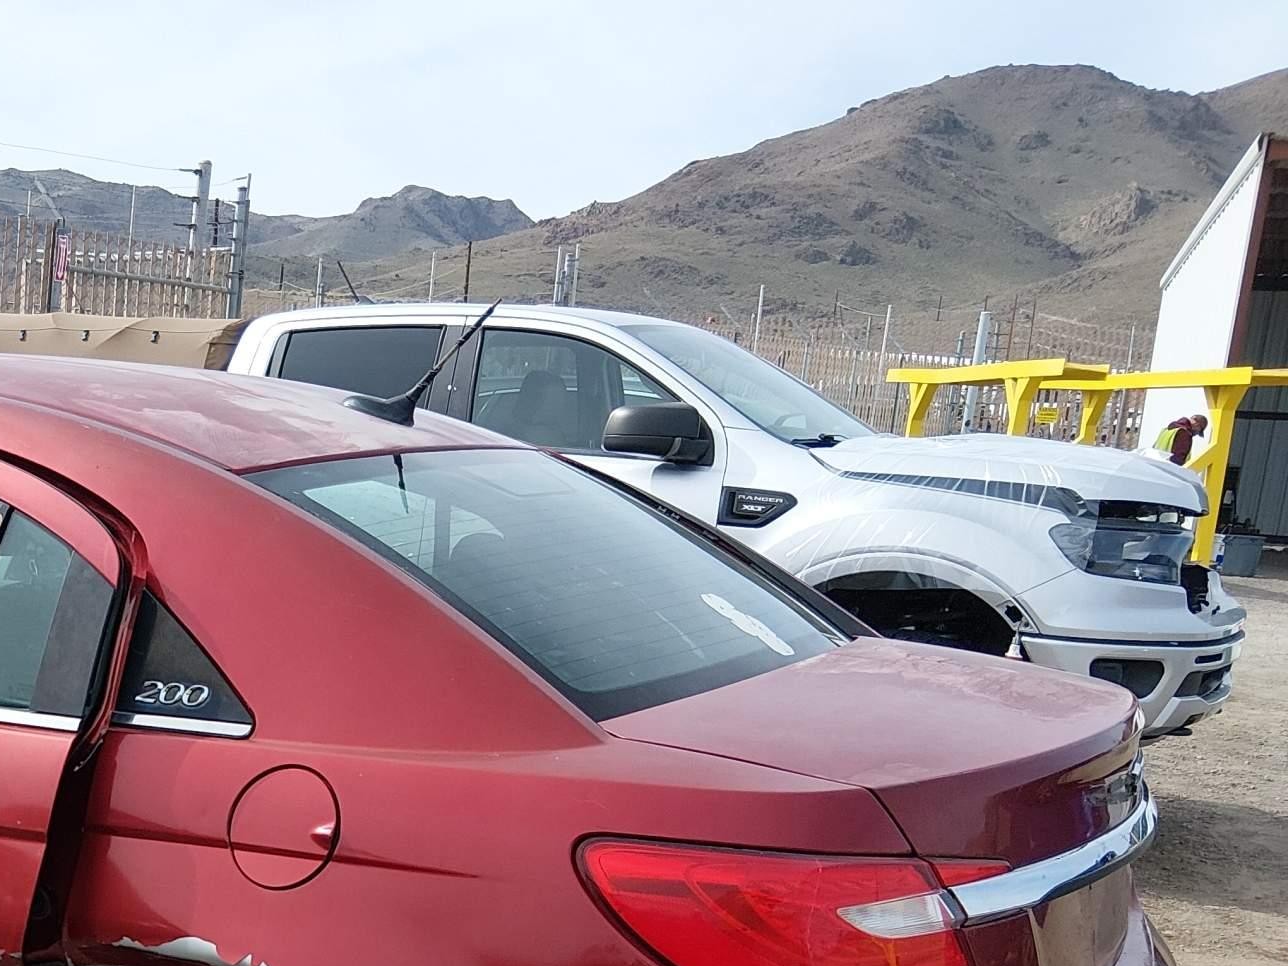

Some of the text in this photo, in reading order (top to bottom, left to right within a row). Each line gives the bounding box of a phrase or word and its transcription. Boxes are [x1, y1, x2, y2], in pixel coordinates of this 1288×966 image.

[738, 494, 784, 503] RANGER
[741, 504, 766, 512] XLT
[134, 680, 209, 706] 200
